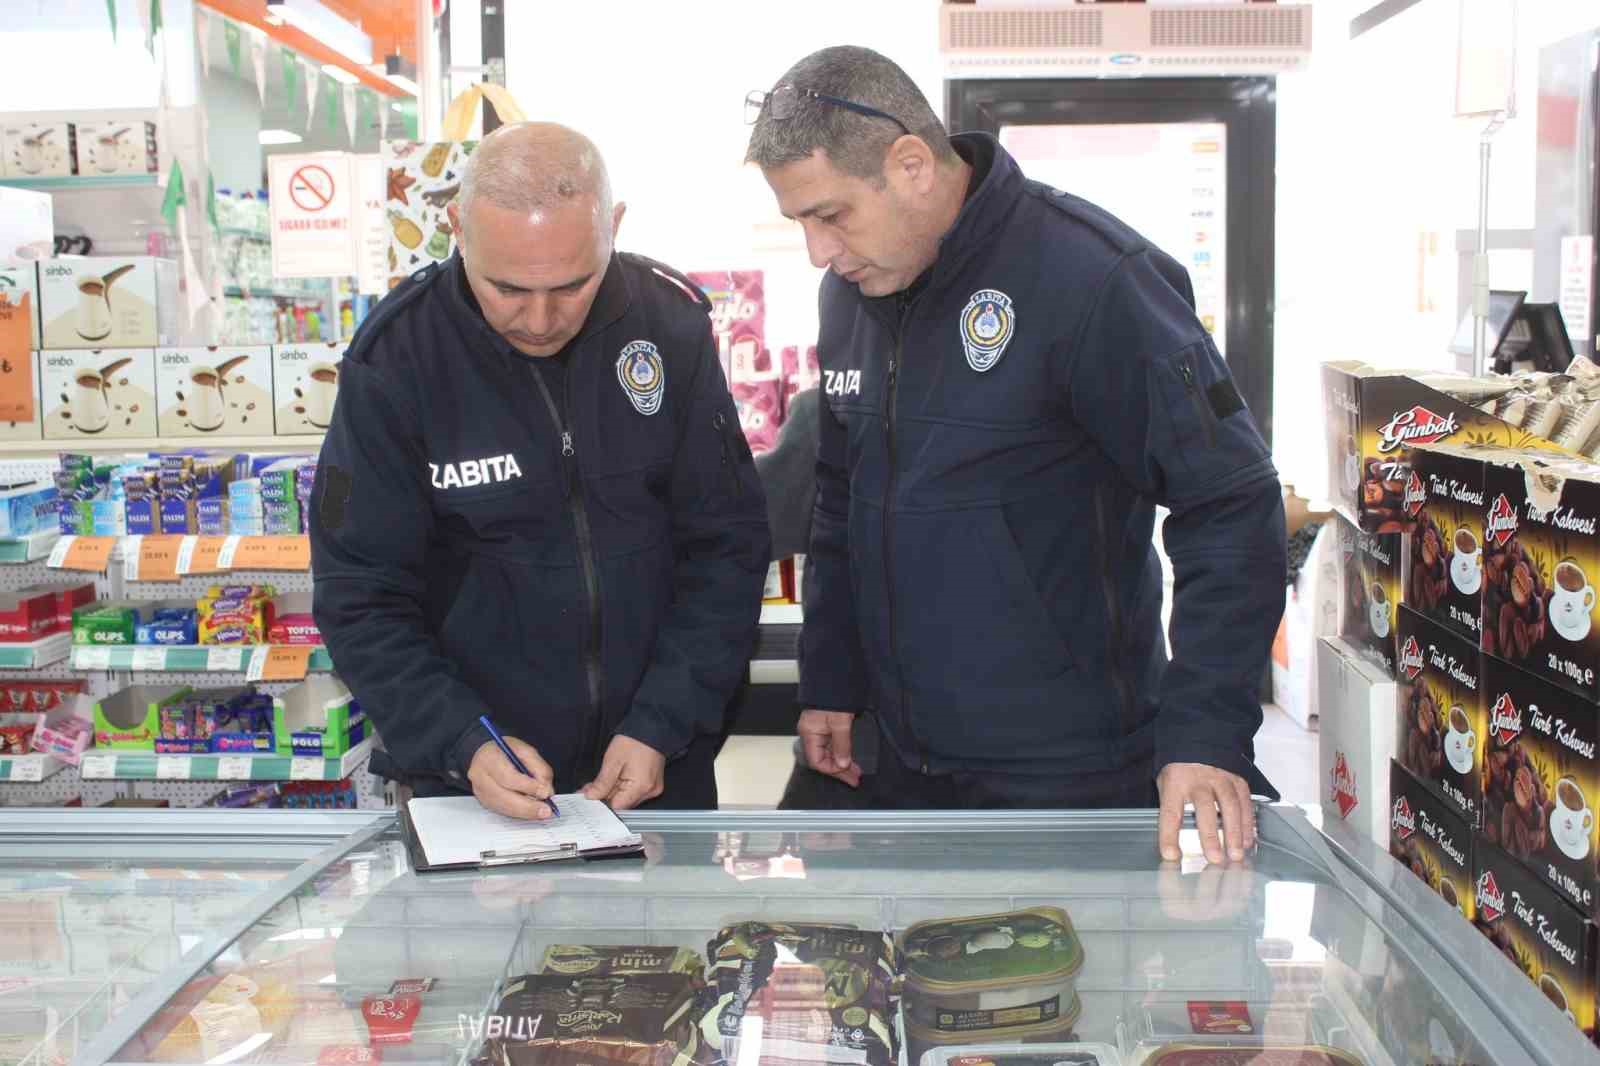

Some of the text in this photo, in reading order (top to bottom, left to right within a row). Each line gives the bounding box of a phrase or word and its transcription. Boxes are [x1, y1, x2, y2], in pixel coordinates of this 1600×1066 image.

[1376, 411, 1458, 452] Günbak
[428, 453, 522, 489] ZABITA
[1430, 474, 1484, 506] Türk Kahvesi
[1551, 507, 1597, 535] Kahvesi
[1429, 645, 1477, 690] Türk Kahvesi
[1548, 653, 1557, 669] 20
[292, 738, 320, 747] POLO
[1529, 704, 1595, 760] Türk Kahvesi
[1419, 810, 1465, 867] Türk Kahvesi
[1511, 891, 1576, 965] Türk Kahvesi
